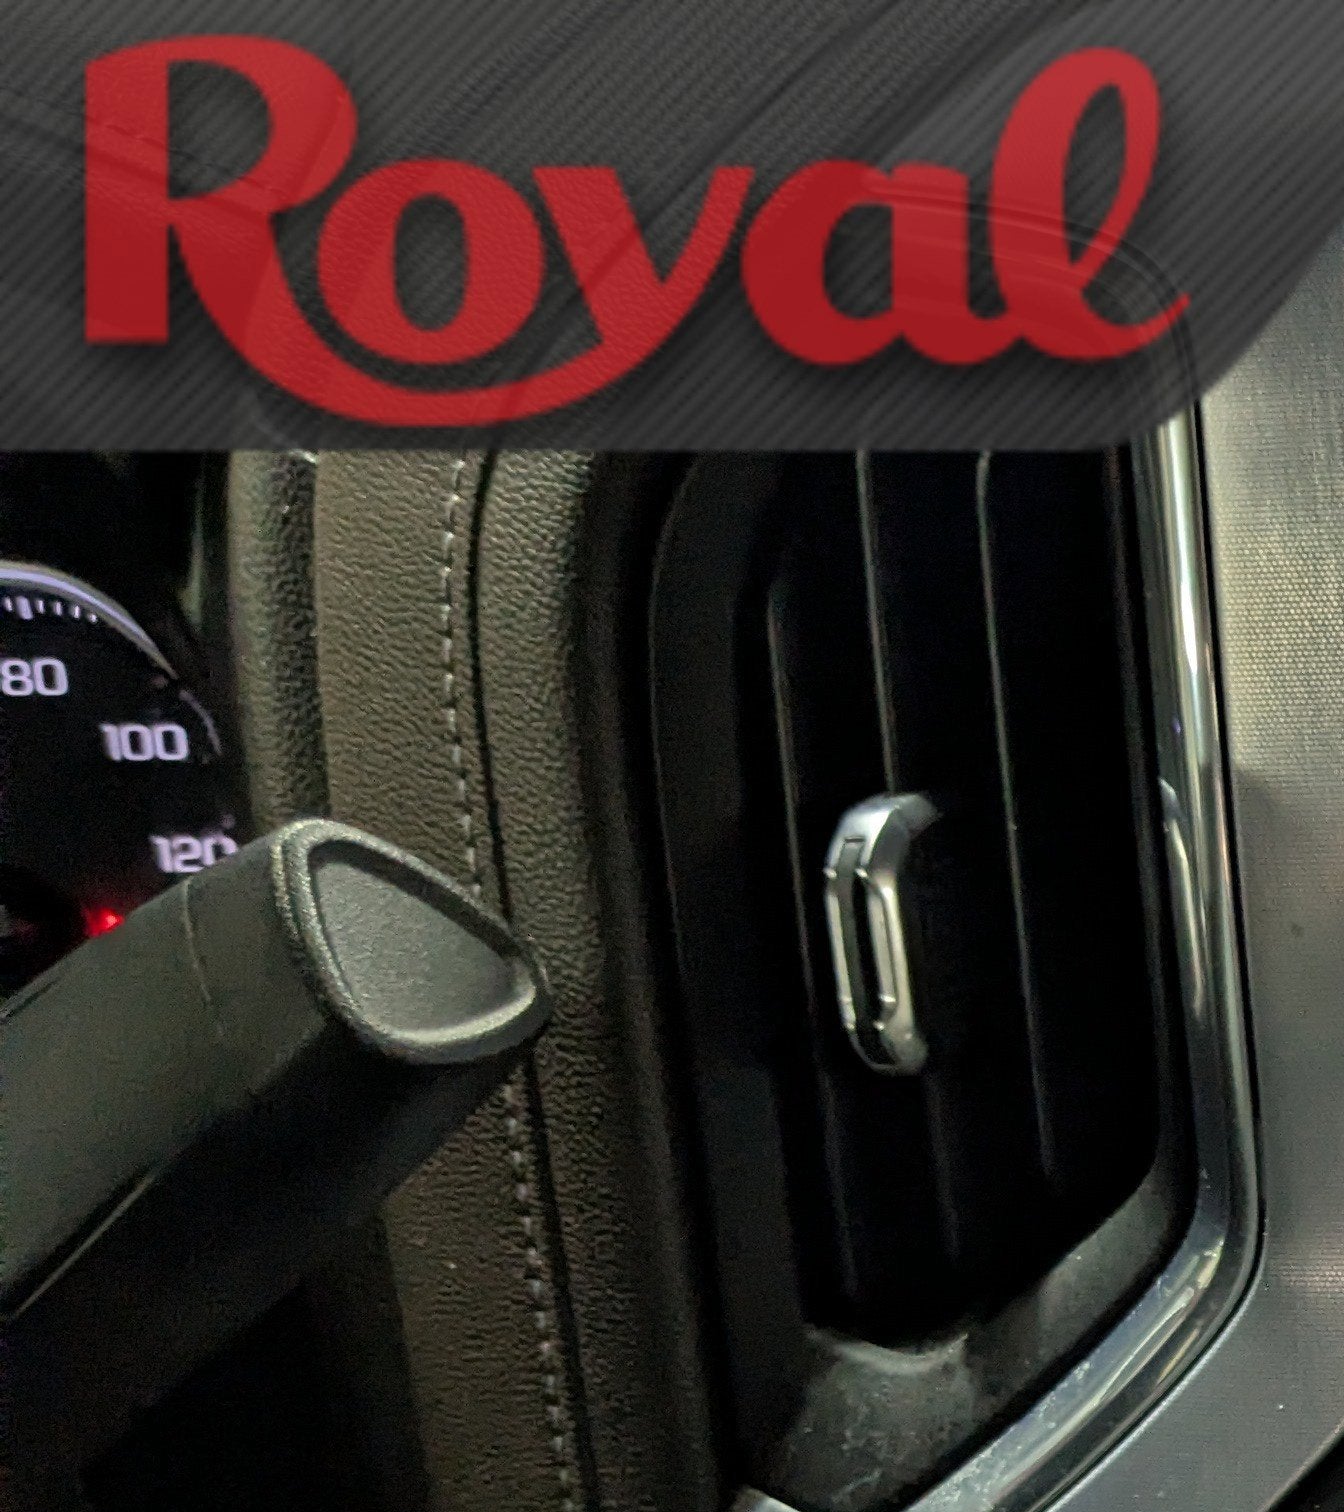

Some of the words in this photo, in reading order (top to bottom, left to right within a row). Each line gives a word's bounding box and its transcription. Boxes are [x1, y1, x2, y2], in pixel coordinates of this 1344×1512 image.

[0, 656, 69, 697] 80
[100, 722, 190, 762] 100
[151, 833, 239, 873] 120
